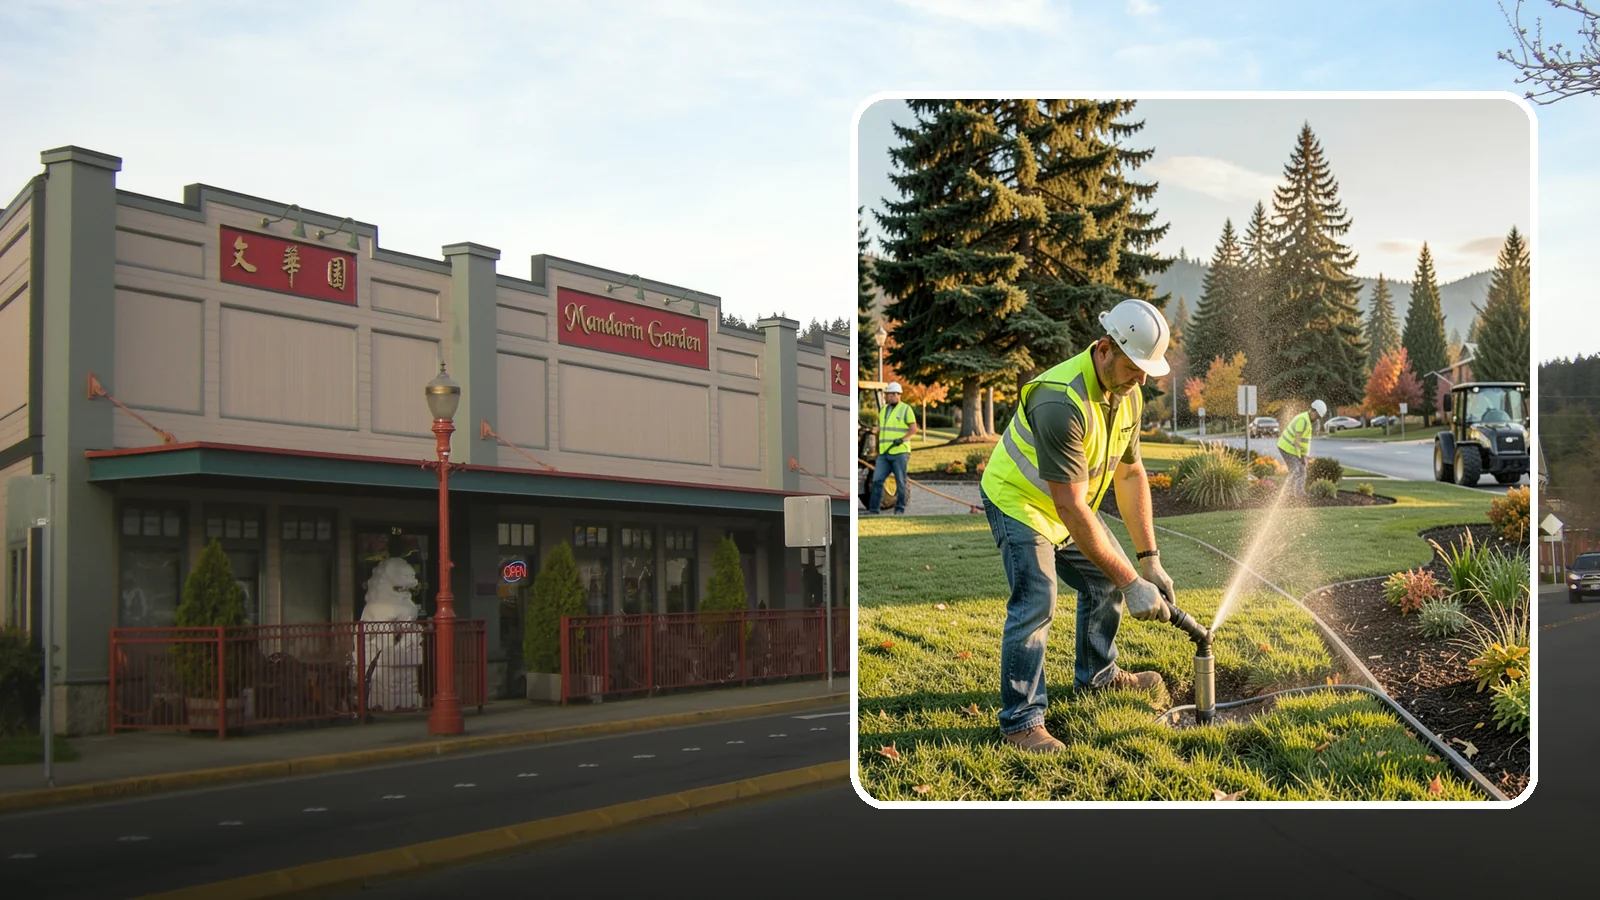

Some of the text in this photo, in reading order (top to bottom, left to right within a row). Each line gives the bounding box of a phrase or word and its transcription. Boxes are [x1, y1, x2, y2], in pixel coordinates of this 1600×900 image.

[564, 302, 702, 352] Mandarin Garden
[503, 565, 527, 578] OPEN
